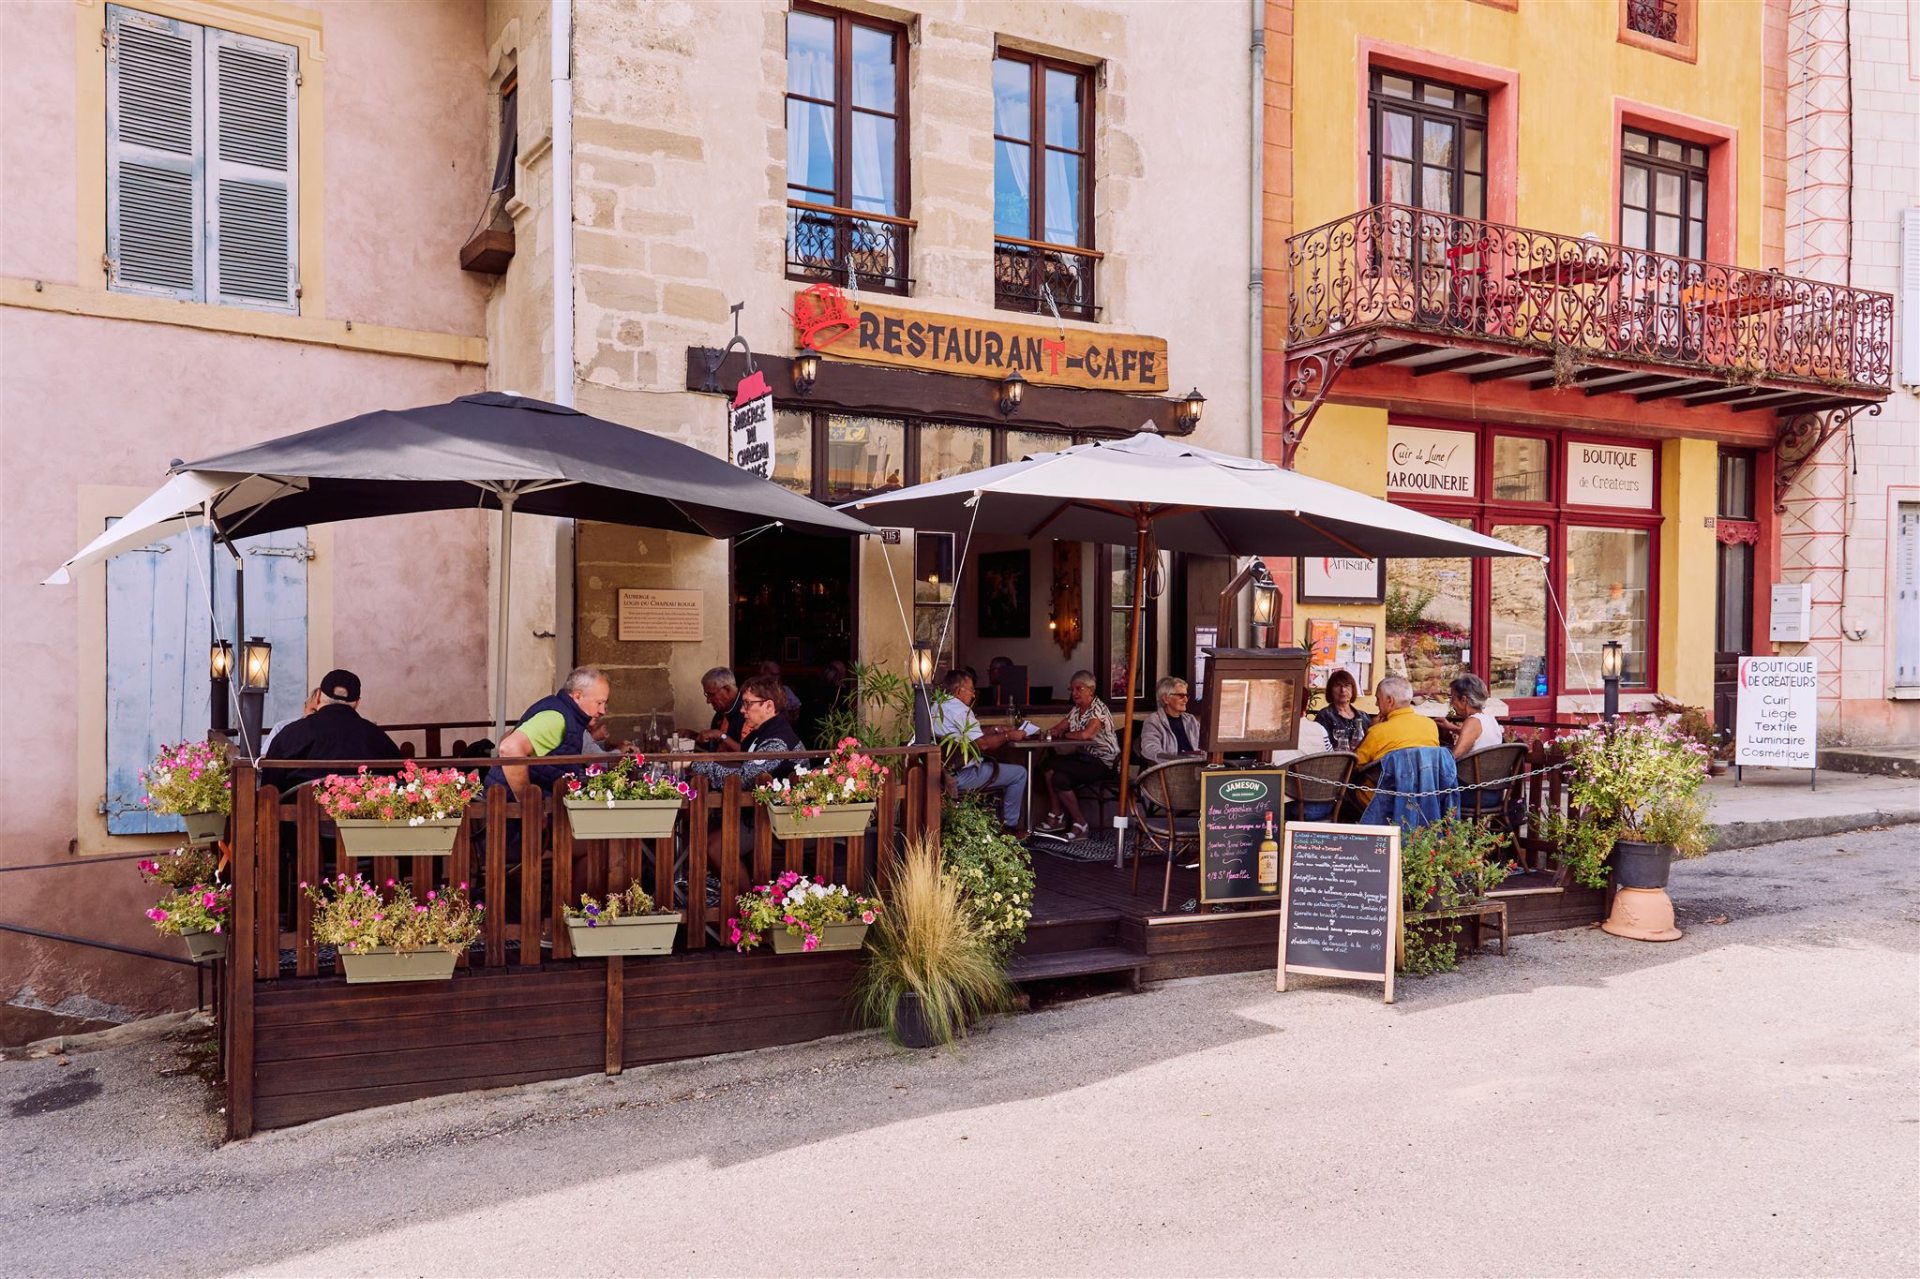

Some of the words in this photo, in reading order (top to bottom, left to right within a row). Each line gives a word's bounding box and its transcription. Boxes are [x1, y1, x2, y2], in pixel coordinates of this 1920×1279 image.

[1392, 442, 1412, 465] Cuir
[1415, 449, 1423, 460] de
[1425, 444, 1450, 468] Lune
[1583, 449, 1637, 469] BOUTIQUE
[1387, 471, 1469, 491] AROQUINERIE
[1579, 477, 1588, 488] de
[885, 531, 896, 540] 115
[1751, 661, 1813, 673] BOUTIQUE
[1748, 675, 1760, 687] DE
[1763, 695, 1789, 705] Cuir
[1755, 722, 1797, 732] Textile
[1748, 735, 1806, 745] Luminaire
[1742, 748, 1810, 761] Cosmétique
[1225, 781, 1260, 792] JAMESON
